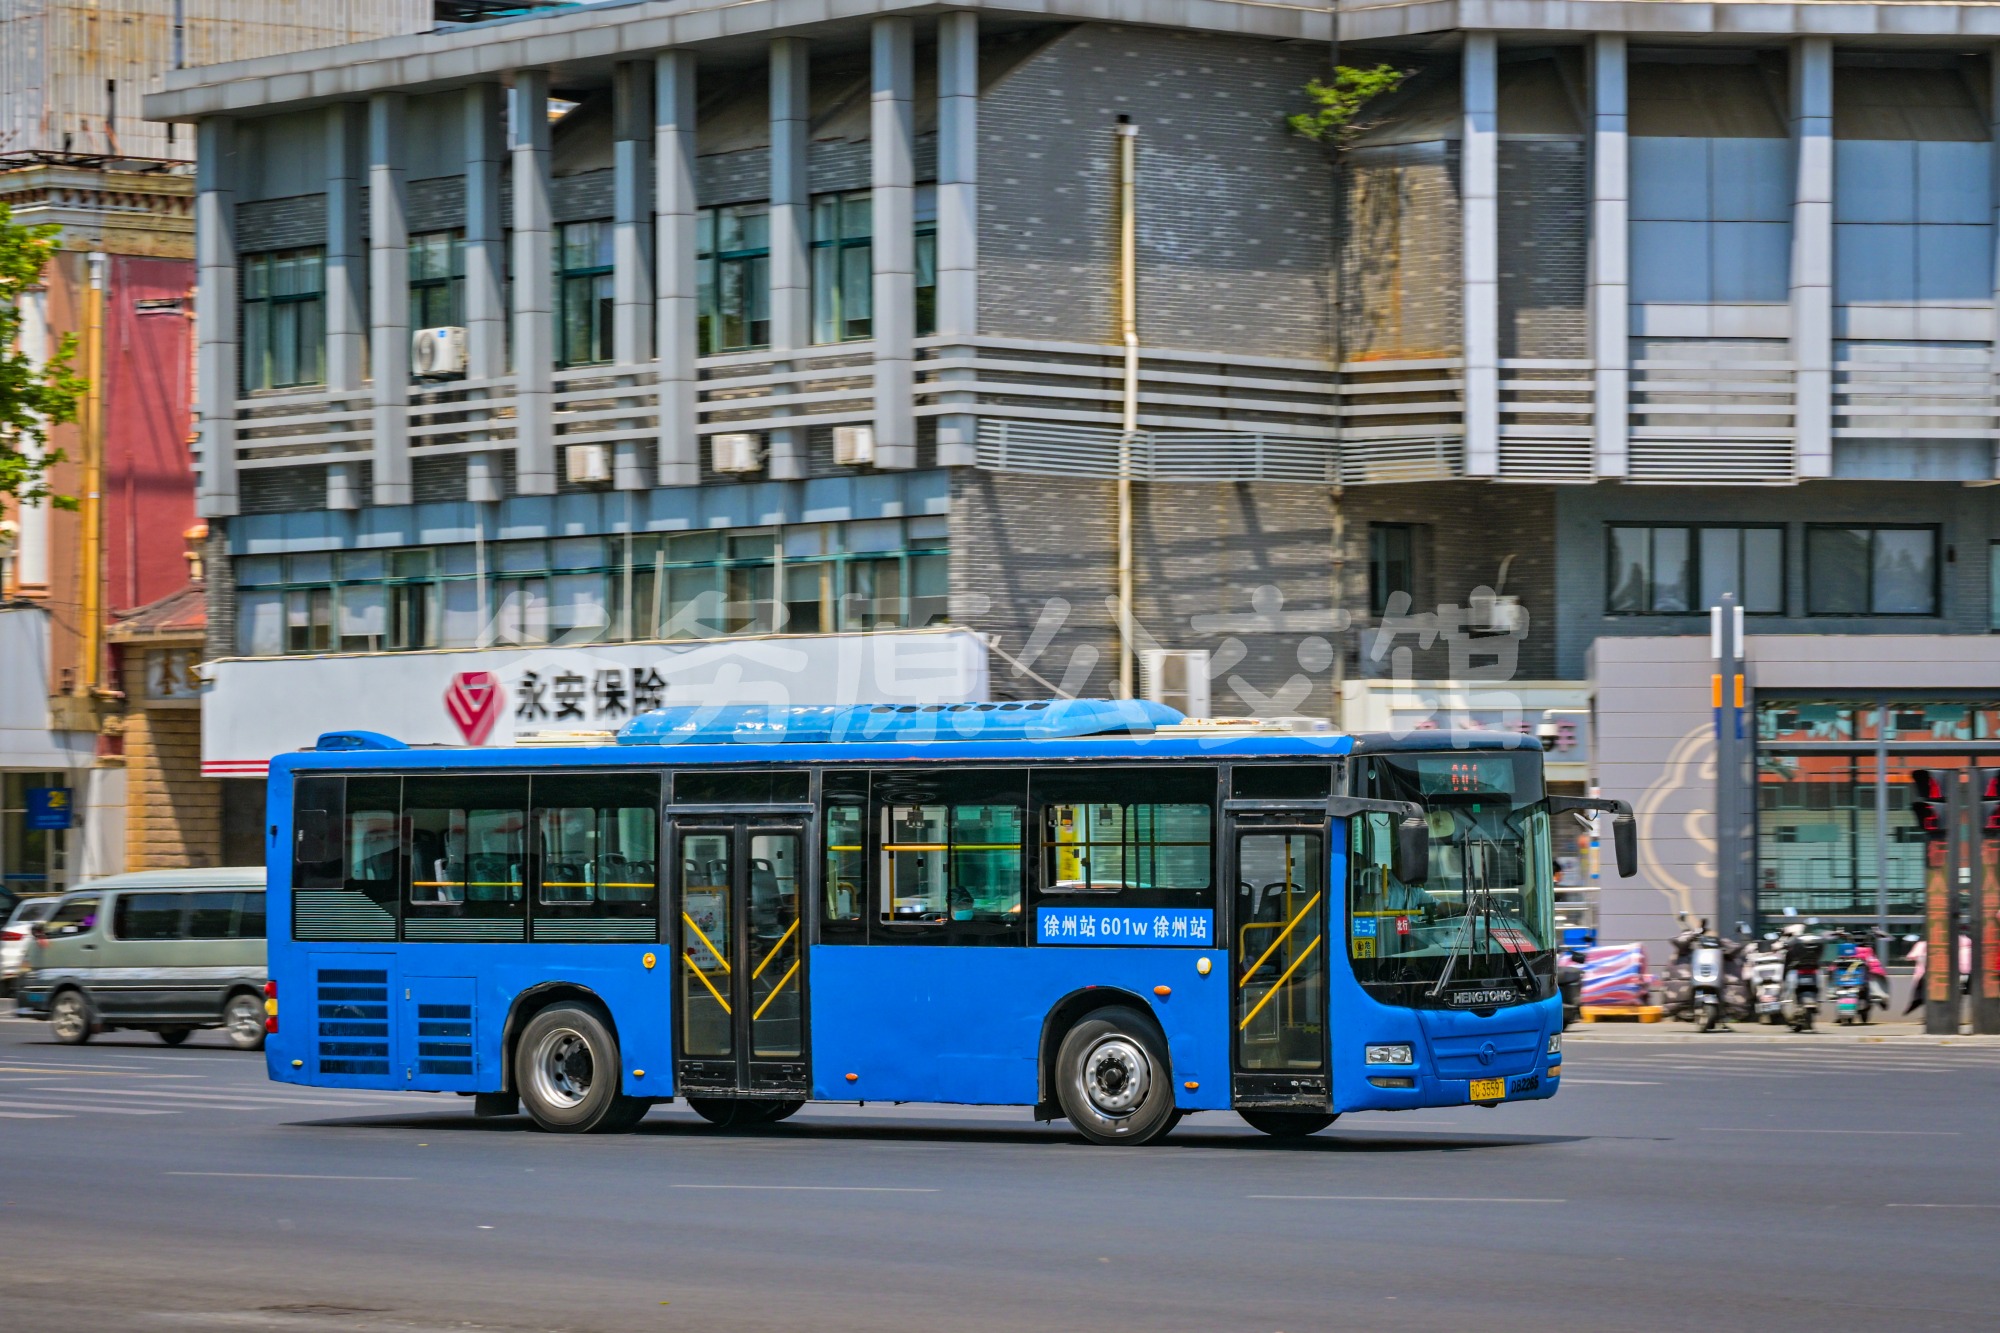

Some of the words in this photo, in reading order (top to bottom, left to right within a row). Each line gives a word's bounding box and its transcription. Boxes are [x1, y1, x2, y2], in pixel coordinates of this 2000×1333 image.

[516, 667, 671, 722] 永安保险
[1043, 914, 1096, 937] 徐州站
[1100, 917, 1148, 936] 601w
[1153, 915, 1207, 939] 徐州站
[1353, 920, 1376, 935] 车二元
[1453, 990, 1512, 1004] HENGTONG
